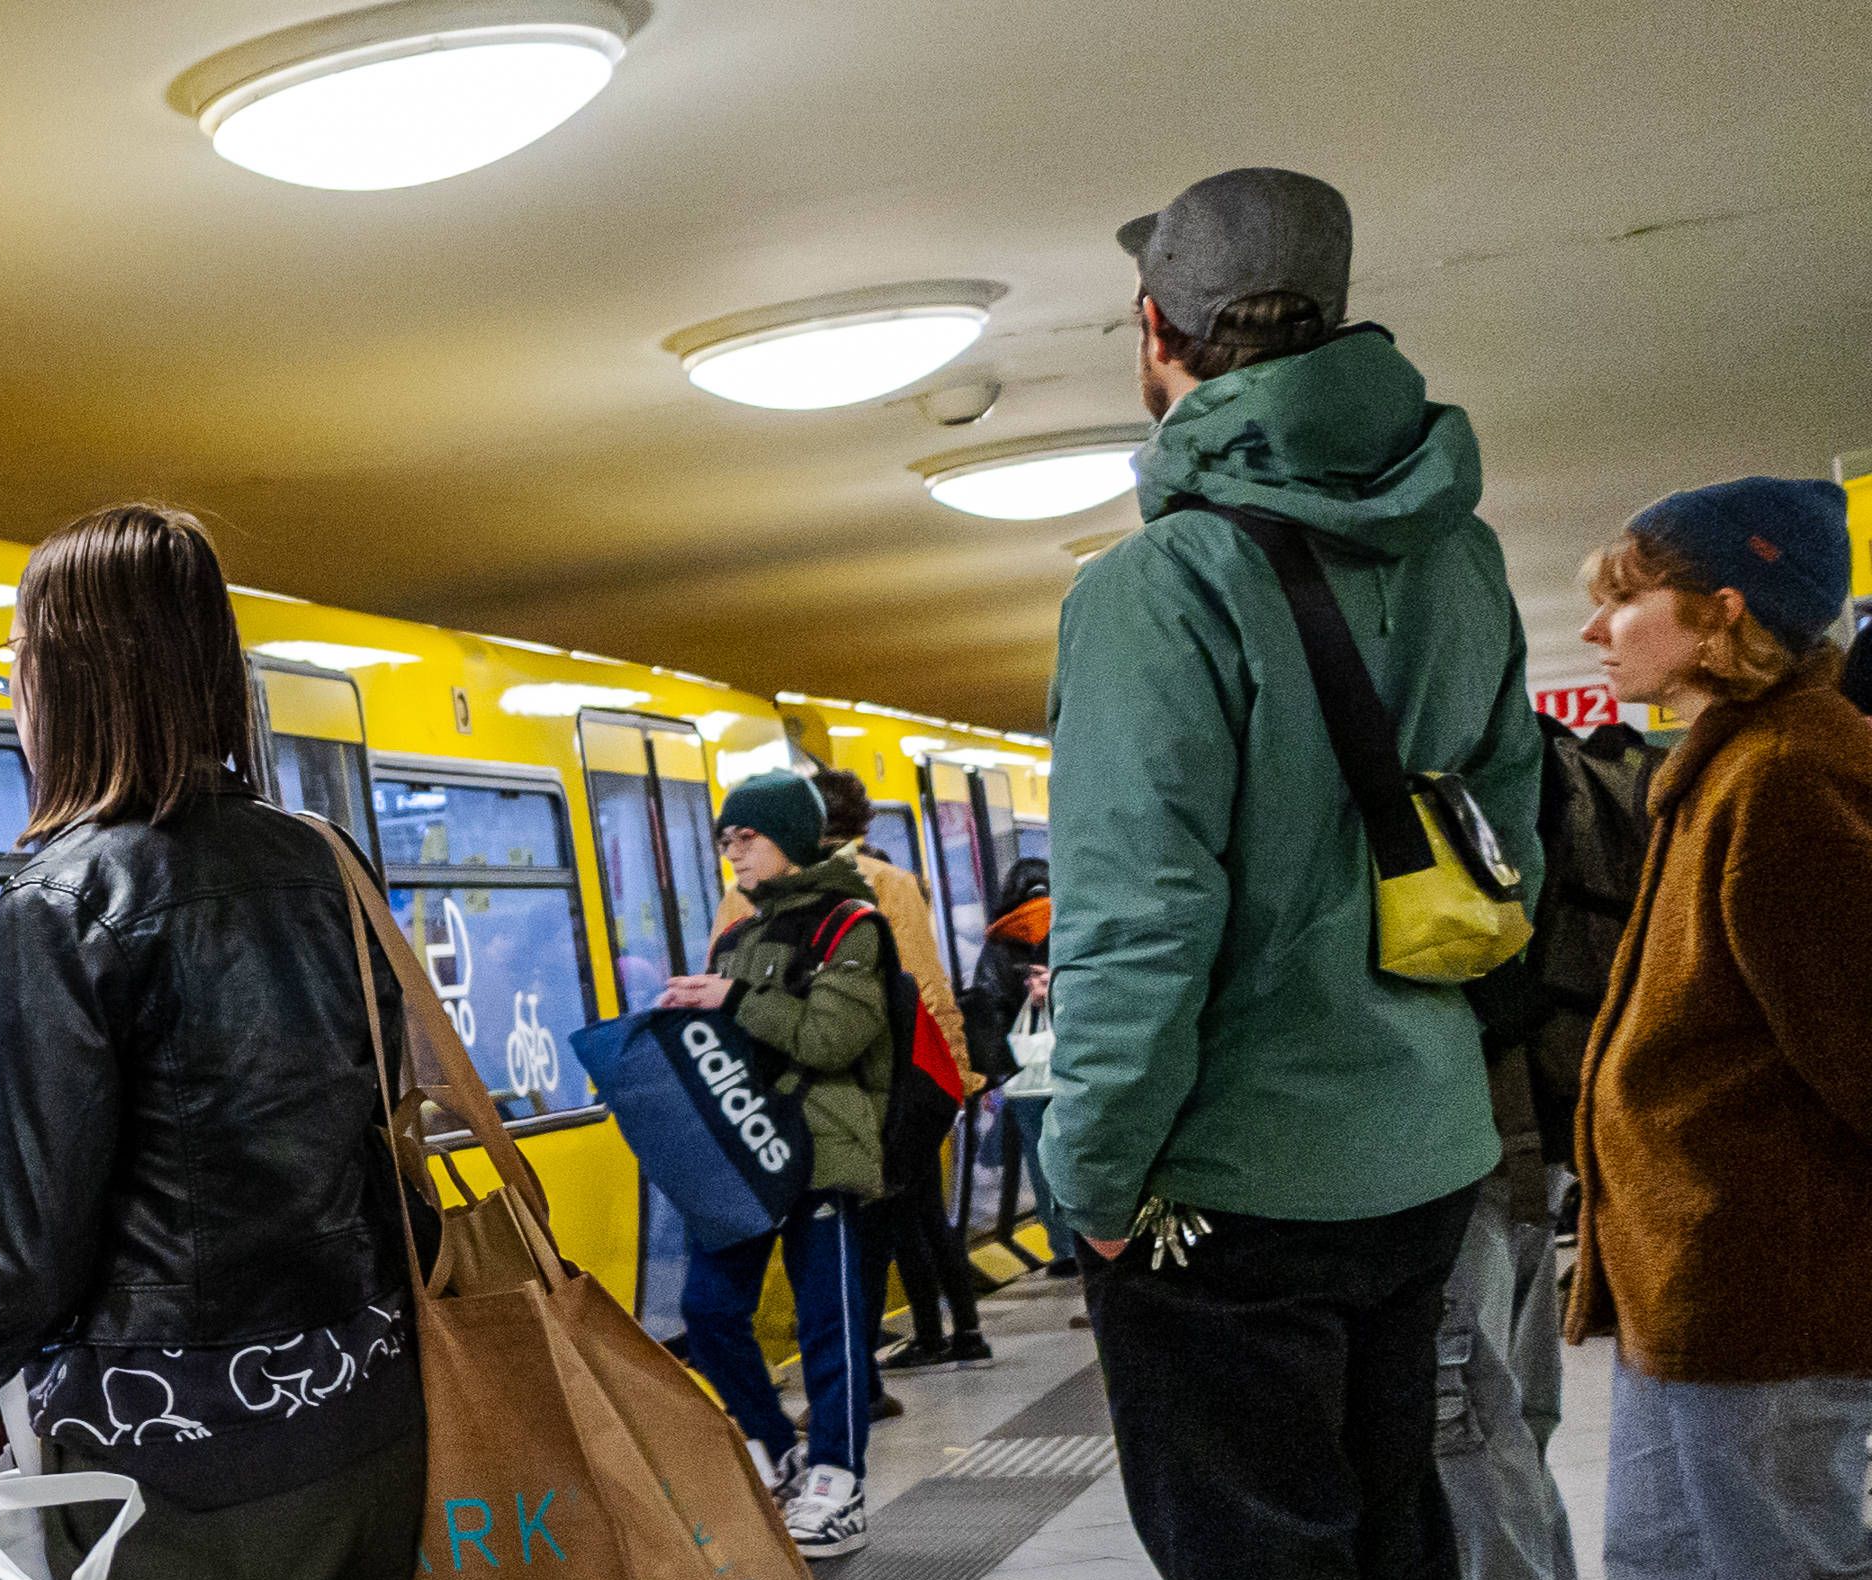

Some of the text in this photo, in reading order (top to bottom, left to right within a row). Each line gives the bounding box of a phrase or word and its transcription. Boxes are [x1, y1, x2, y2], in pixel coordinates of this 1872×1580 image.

[1544, 688, 1611, 726] U2
[681, 1020, 792, 1174] adidas
[418, 1488, 568, 1574] RK
